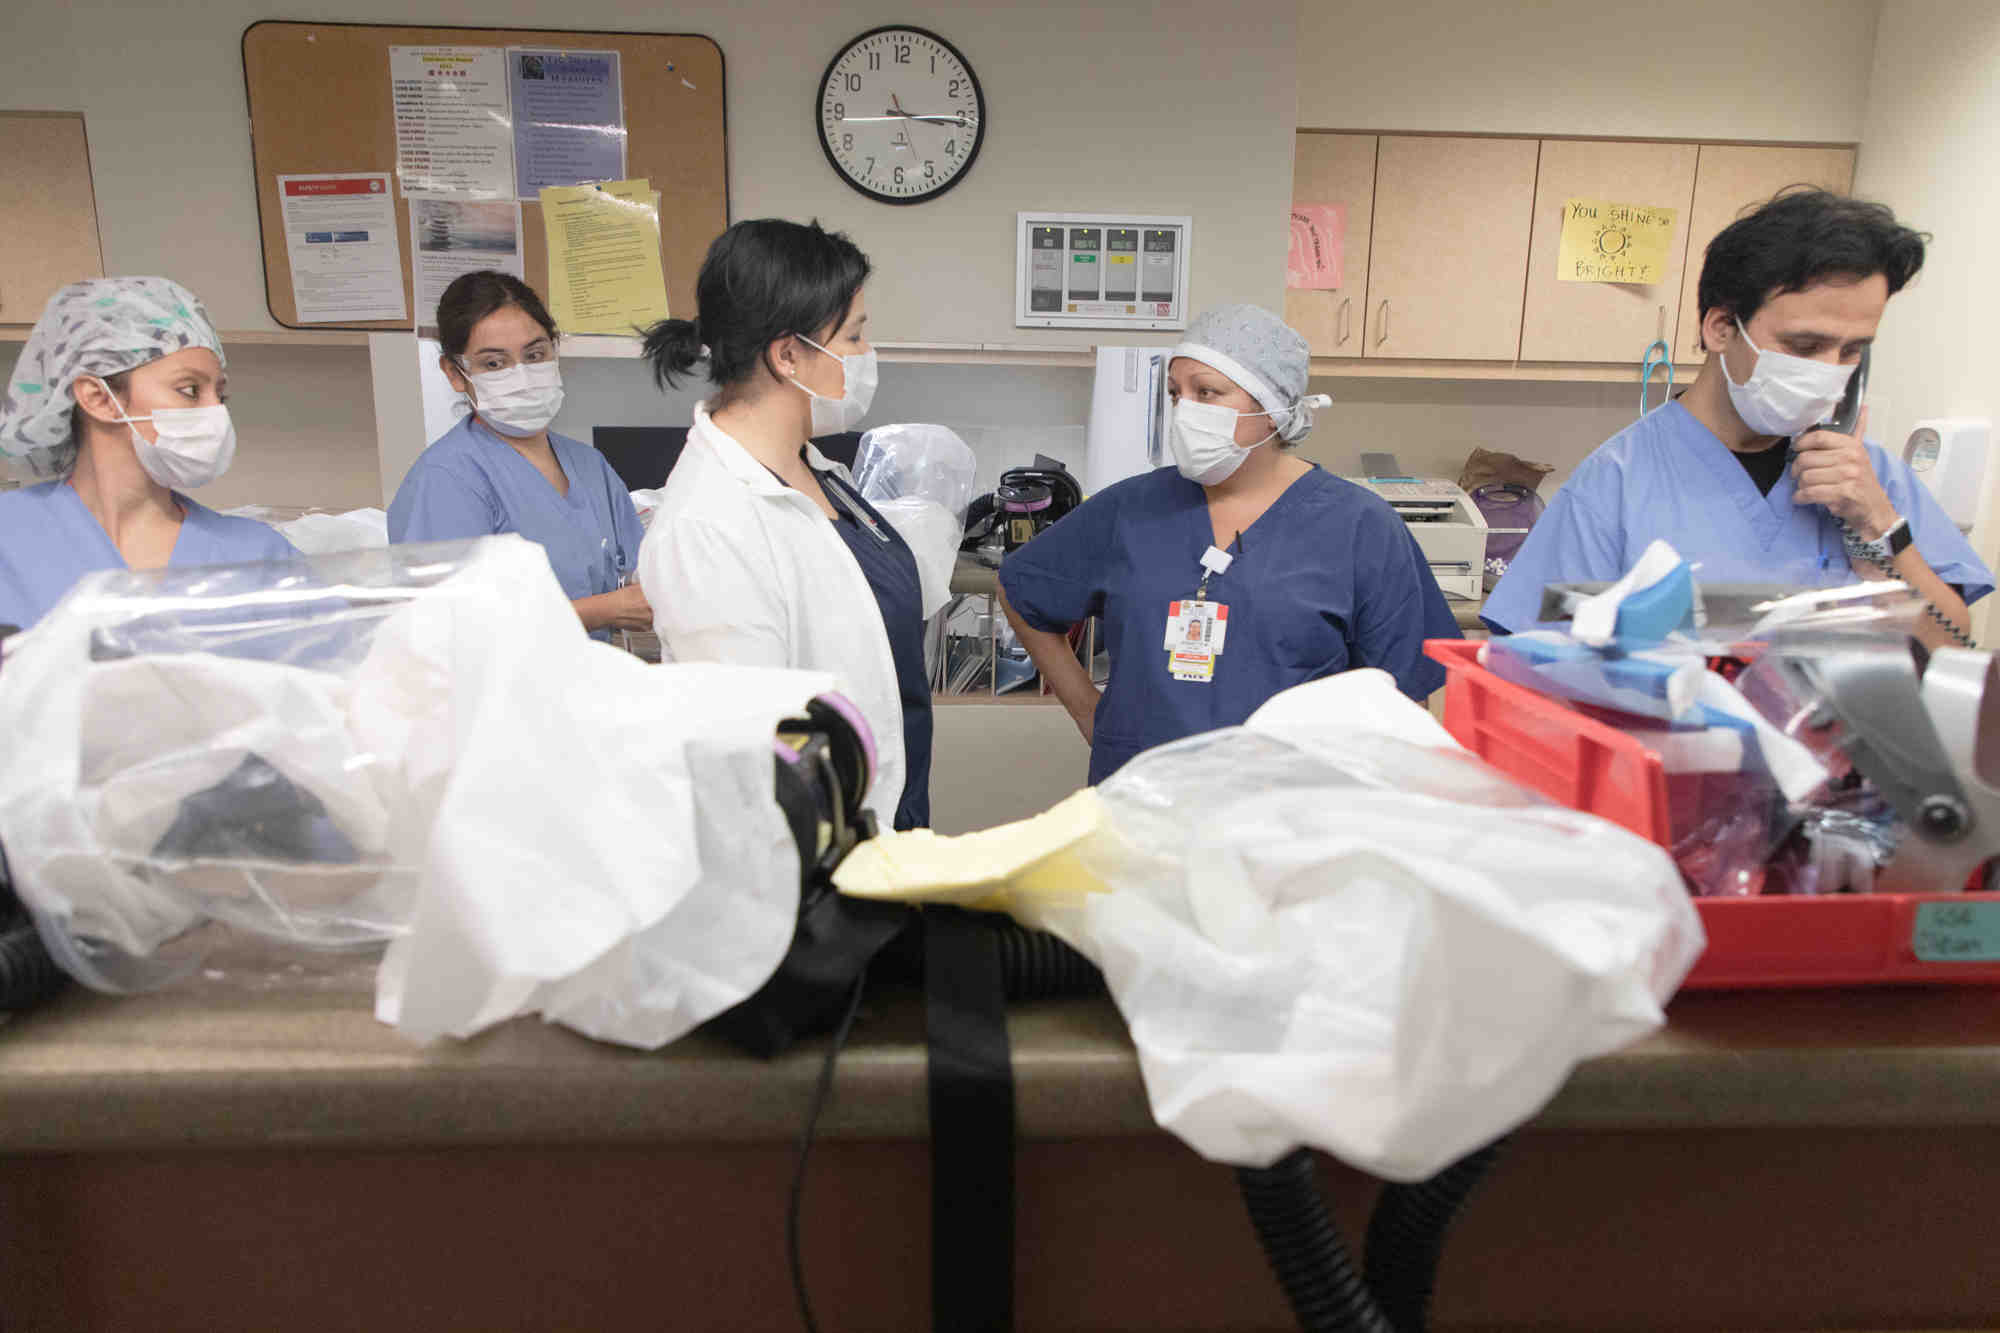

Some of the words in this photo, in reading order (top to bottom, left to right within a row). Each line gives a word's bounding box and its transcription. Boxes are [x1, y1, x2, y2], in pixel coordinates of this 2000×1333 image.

[868, 52, 880, 71] 11
[894, 44, 911, 64] 12
[930, 55, 935, 74] 1
[844, 73, 862, 92] 10
[948, 79, 960, 98] 2
[834, 103, 845, 121] 9
[843, 134, 853, 151] 8
[945, 139, 955, 157] 4
[865, 157, 876, 175] 7
[894, 166, 904, 184] 6
[924, 160, 934, 178] 5
